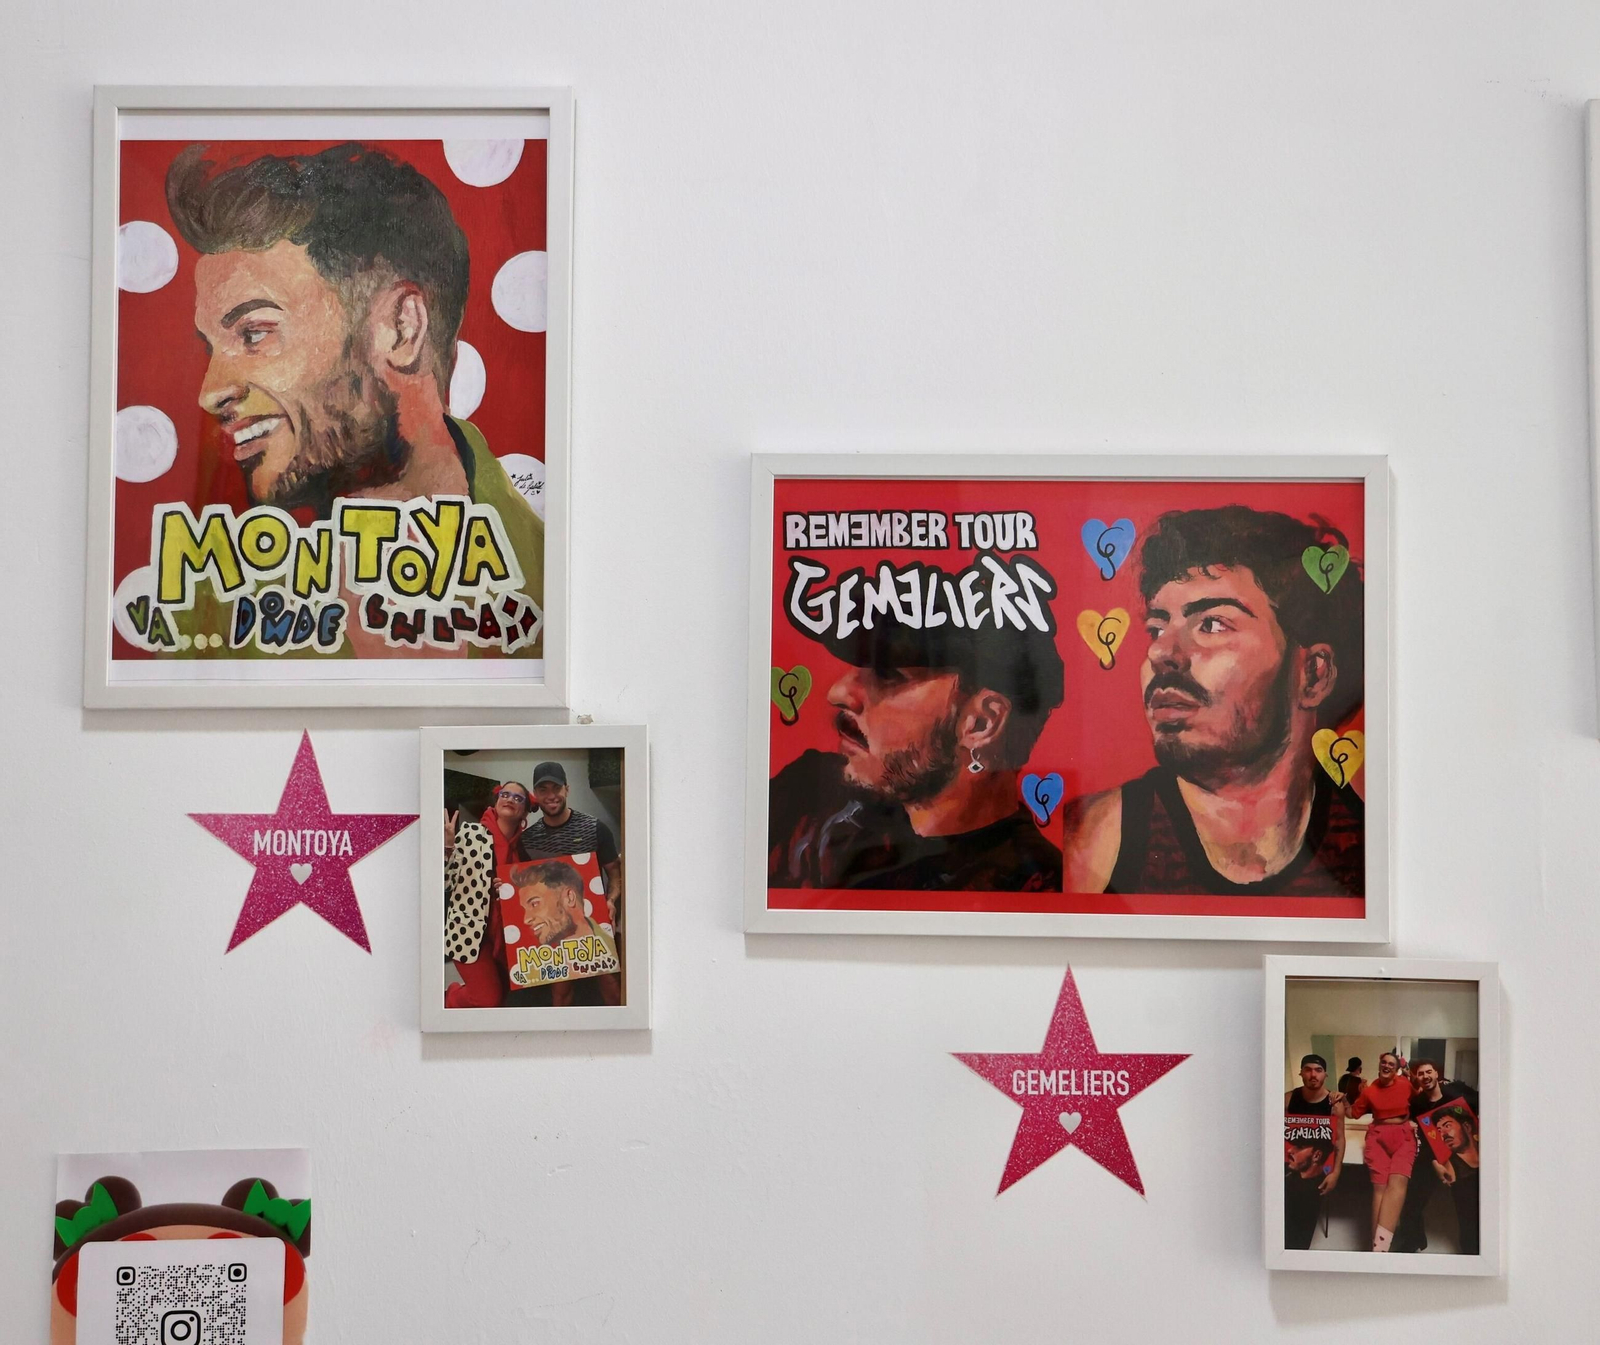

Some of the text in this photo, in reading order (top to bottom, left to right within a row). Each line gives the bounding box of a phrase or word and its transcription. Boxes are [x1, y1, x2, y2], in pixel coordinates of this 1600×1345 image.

[783, 511, 1037, 551] REMEMBER TOUR
[157, 501, 508, 604] MONTOYA
[789, 555, 1052, 640] GEMELIERS
[234, 591, 345, 645] DONDE
[253, 829, 353, 856] MONTOYA
[519, 936, 607, 972] MONTOYA
[1012, 1069, 1130, 1096] GEMELIERS
